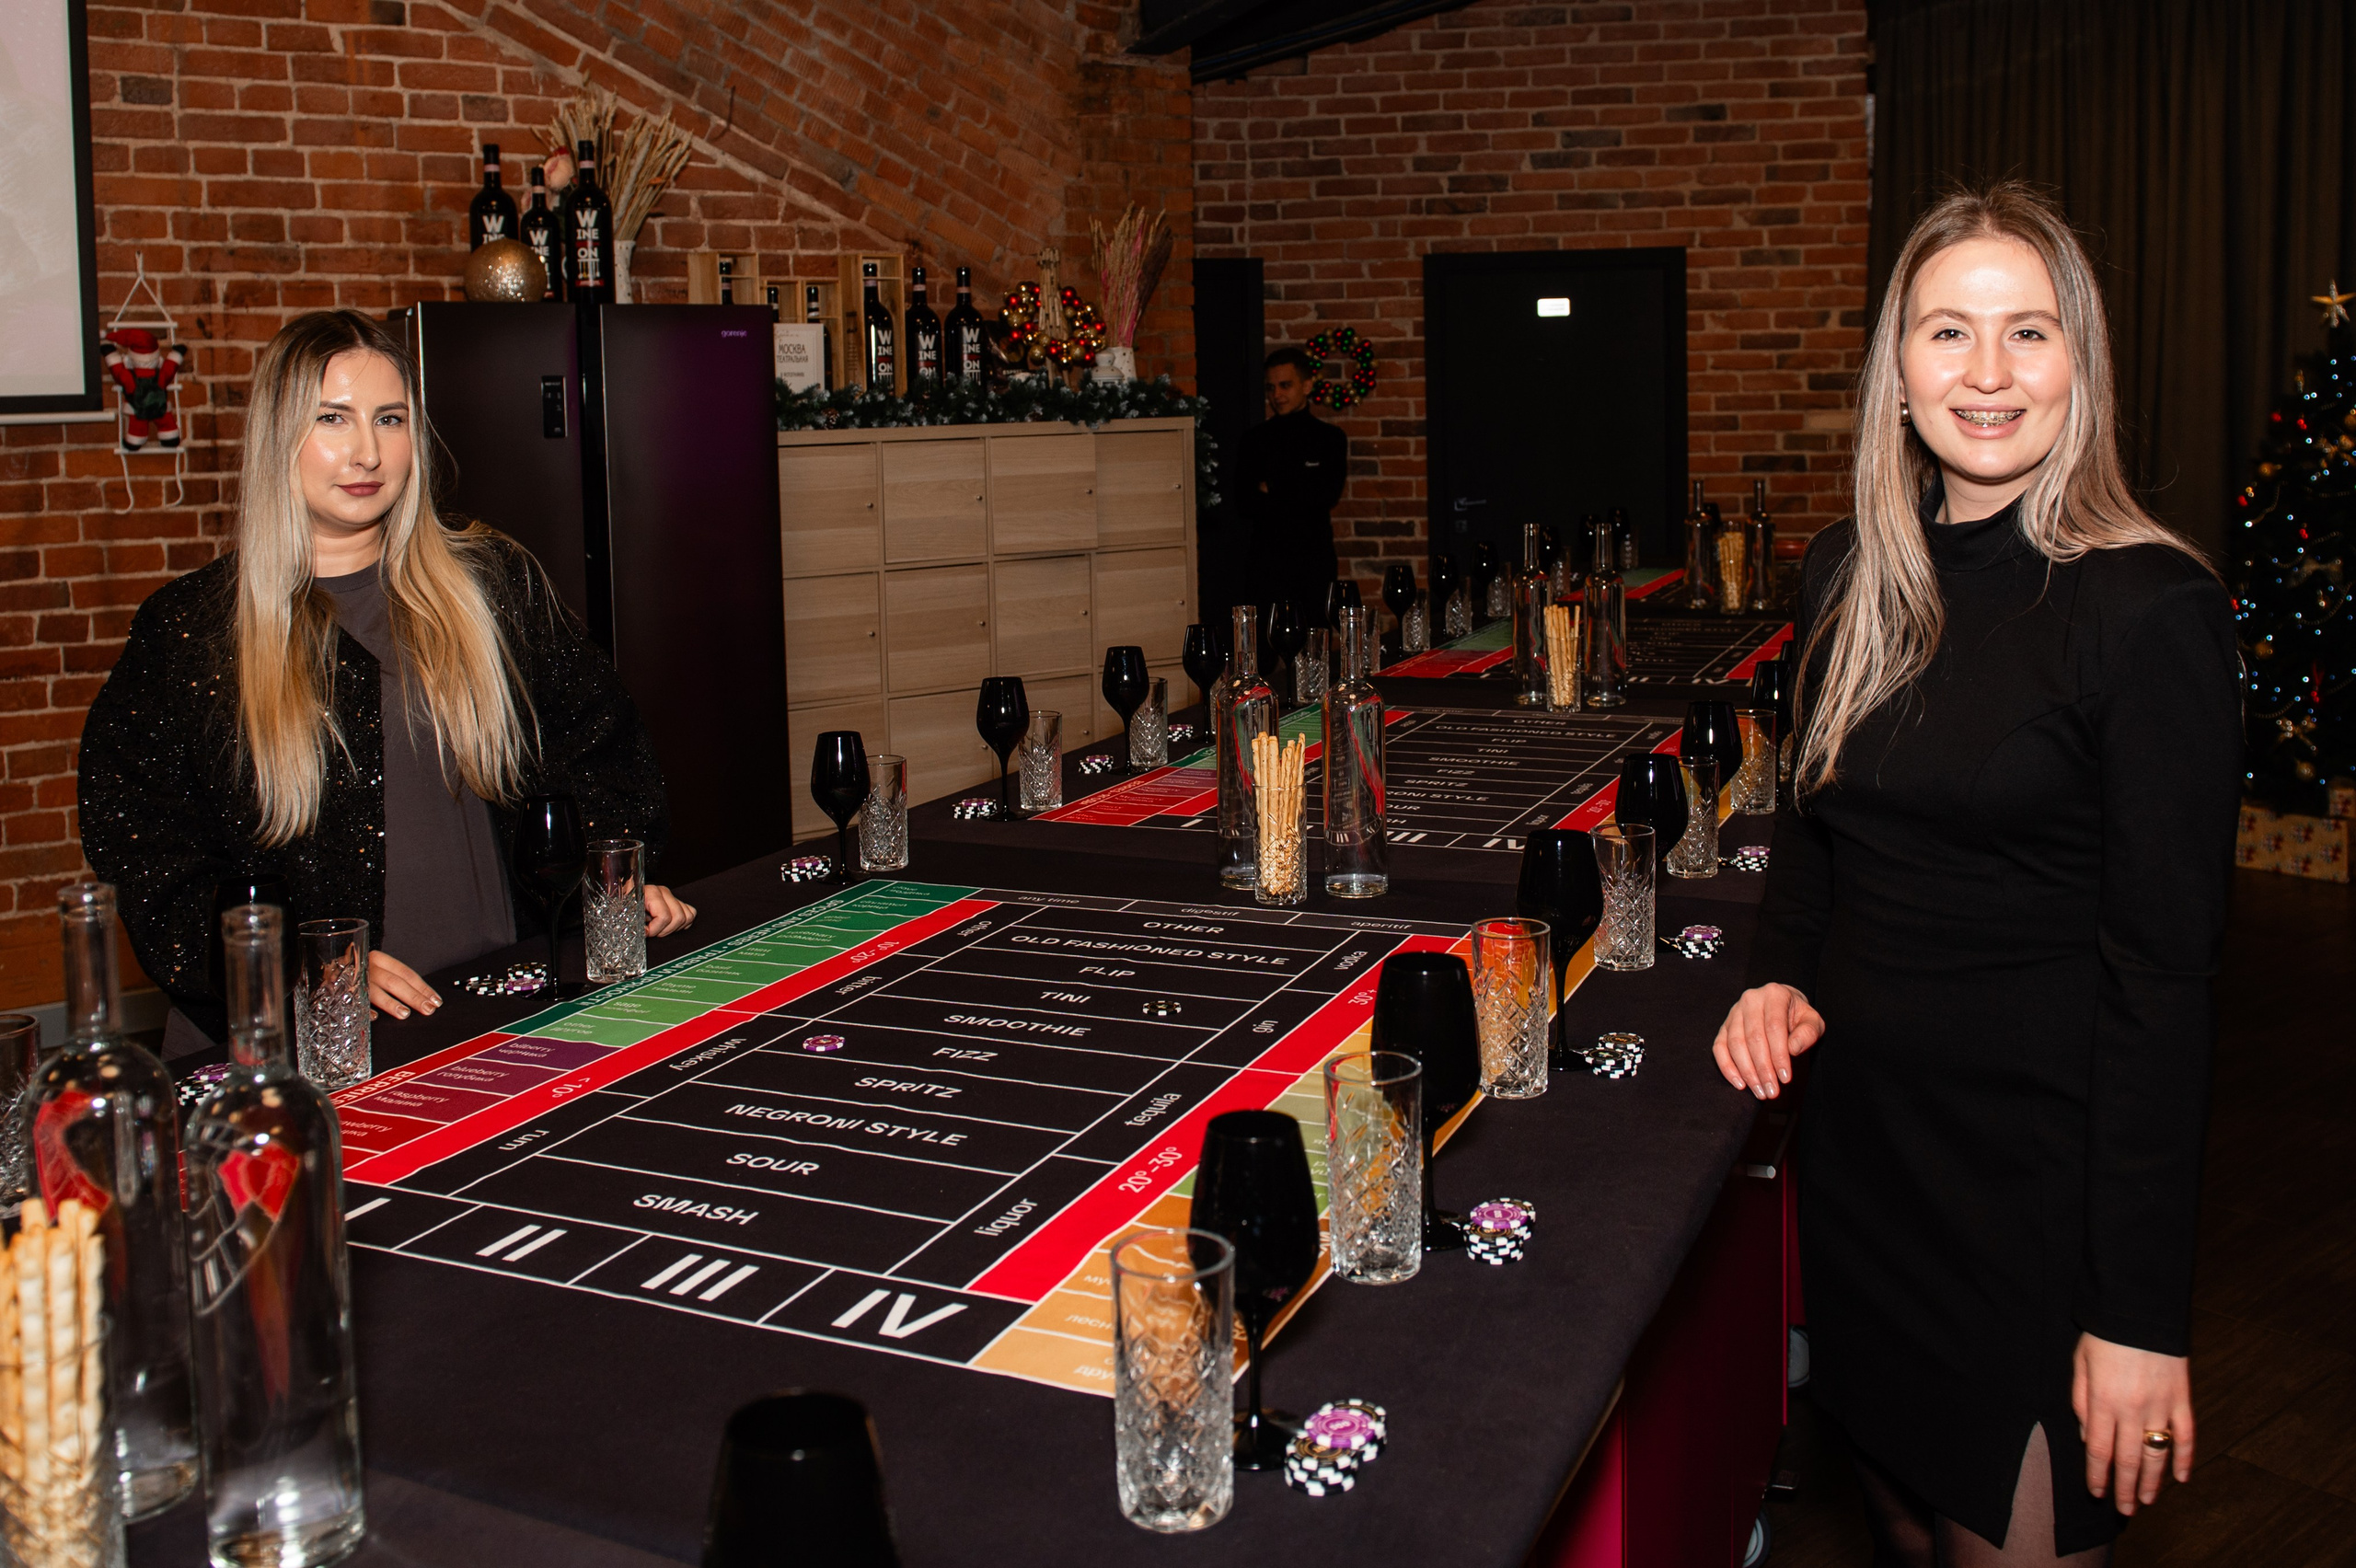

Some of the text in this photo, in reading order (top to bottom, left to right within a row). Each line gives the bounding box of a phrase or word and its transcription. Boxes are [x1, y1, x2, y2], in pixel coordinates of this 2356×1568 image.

[531, 246, 550, 256] NE
[778, 343, 806, 354] МОСКВА
[777, 355, 809, 363] ТЕАТРАЛЬНАЯ
[1470, 726, 1562, 736] FASHIONED
[1428, 756, 1520, 767] SMOOTHIE
[1404, 778, 1469, 788] SPRITZ
[1386, 790, 1489, 801] RONI STYLE
[1181, 907, 1240, 917] digestif
[957, 920, 992, 937] other
[1143, 921, 1225, 934] OTHER
[1350, 921, 1412, 929] aperitif
[1011, 935, 1290, 965] OLD FASHIONED STYLE
[1334, 951, 1369, 970] vodka
[1078, 966, 1136, 977] FLIP
[835, 975, 883, 996] bitter
[1040, 991, 1091, 1004] TINI
[943, 1014, 1091, 1037] SMOOTHIE
[1252, 1020, 1278, 1033] gin
[668, 1038, 747, 1071] whiskey
[932, 1047, 999, 1062] FIZZ
[854, 1077, 963, 1099] SPRITZ
[1124, 1093, 1182, 1126] tequila
[724, 1103, 968, 1147] NEGRONI STYLE
[498, 1129, 550, 1150] rum
[725, 1153, 820, 1176] SOUR
[633, 1193, 759, 1226] SMASH
[974, 1198, 1038, 1237] liquor
[475, 1224, 568, 1262] II
[640, 1253, 760, 1302] III
[831, 1288, 968, 1339] IV
